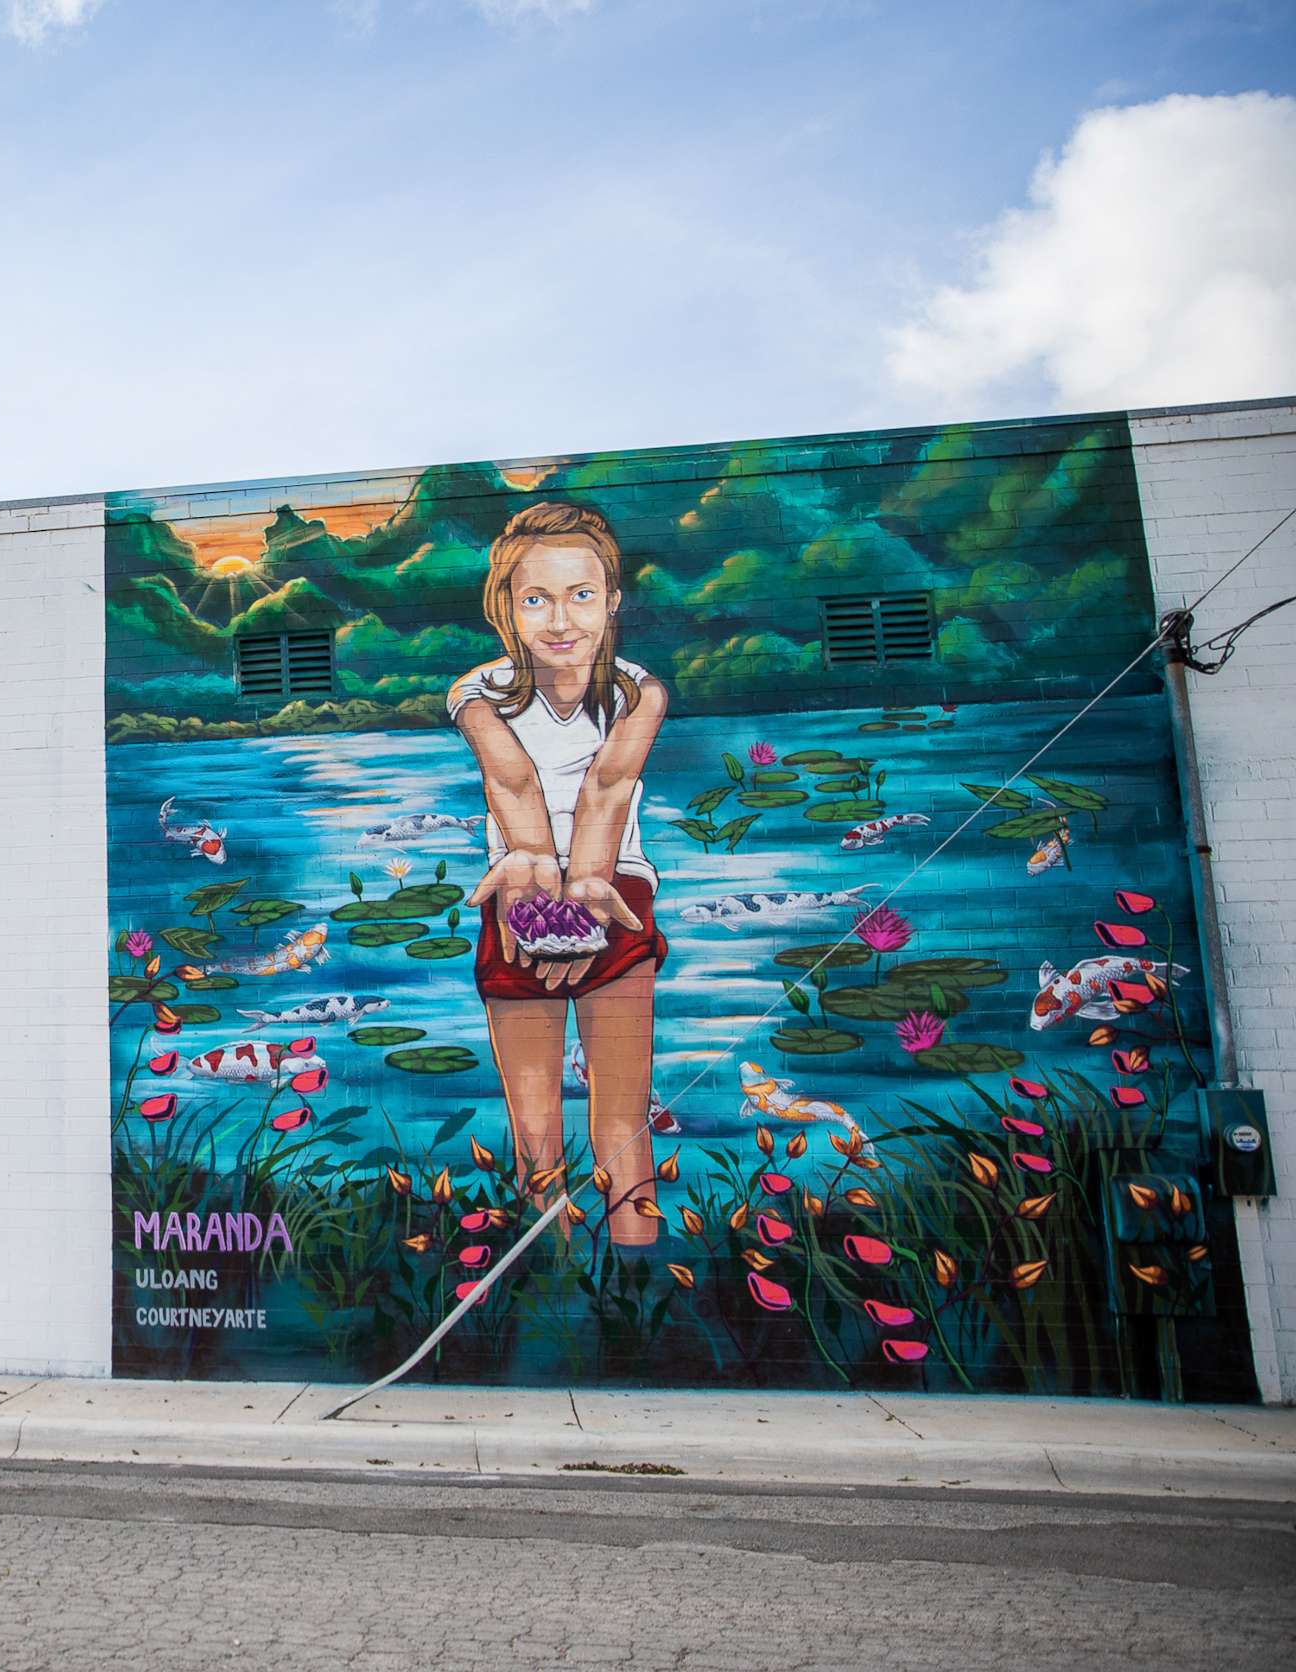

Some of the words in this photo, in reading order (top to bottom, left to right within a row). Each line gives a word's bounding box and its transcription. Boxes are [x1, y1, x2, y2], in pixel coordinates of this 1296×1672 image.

[134, 1211, 293, 1251] MARANDA
[135, 1268, 219, 1290] ULOANG
[135, 1307, 267, 1328] COURTNEYARTE
